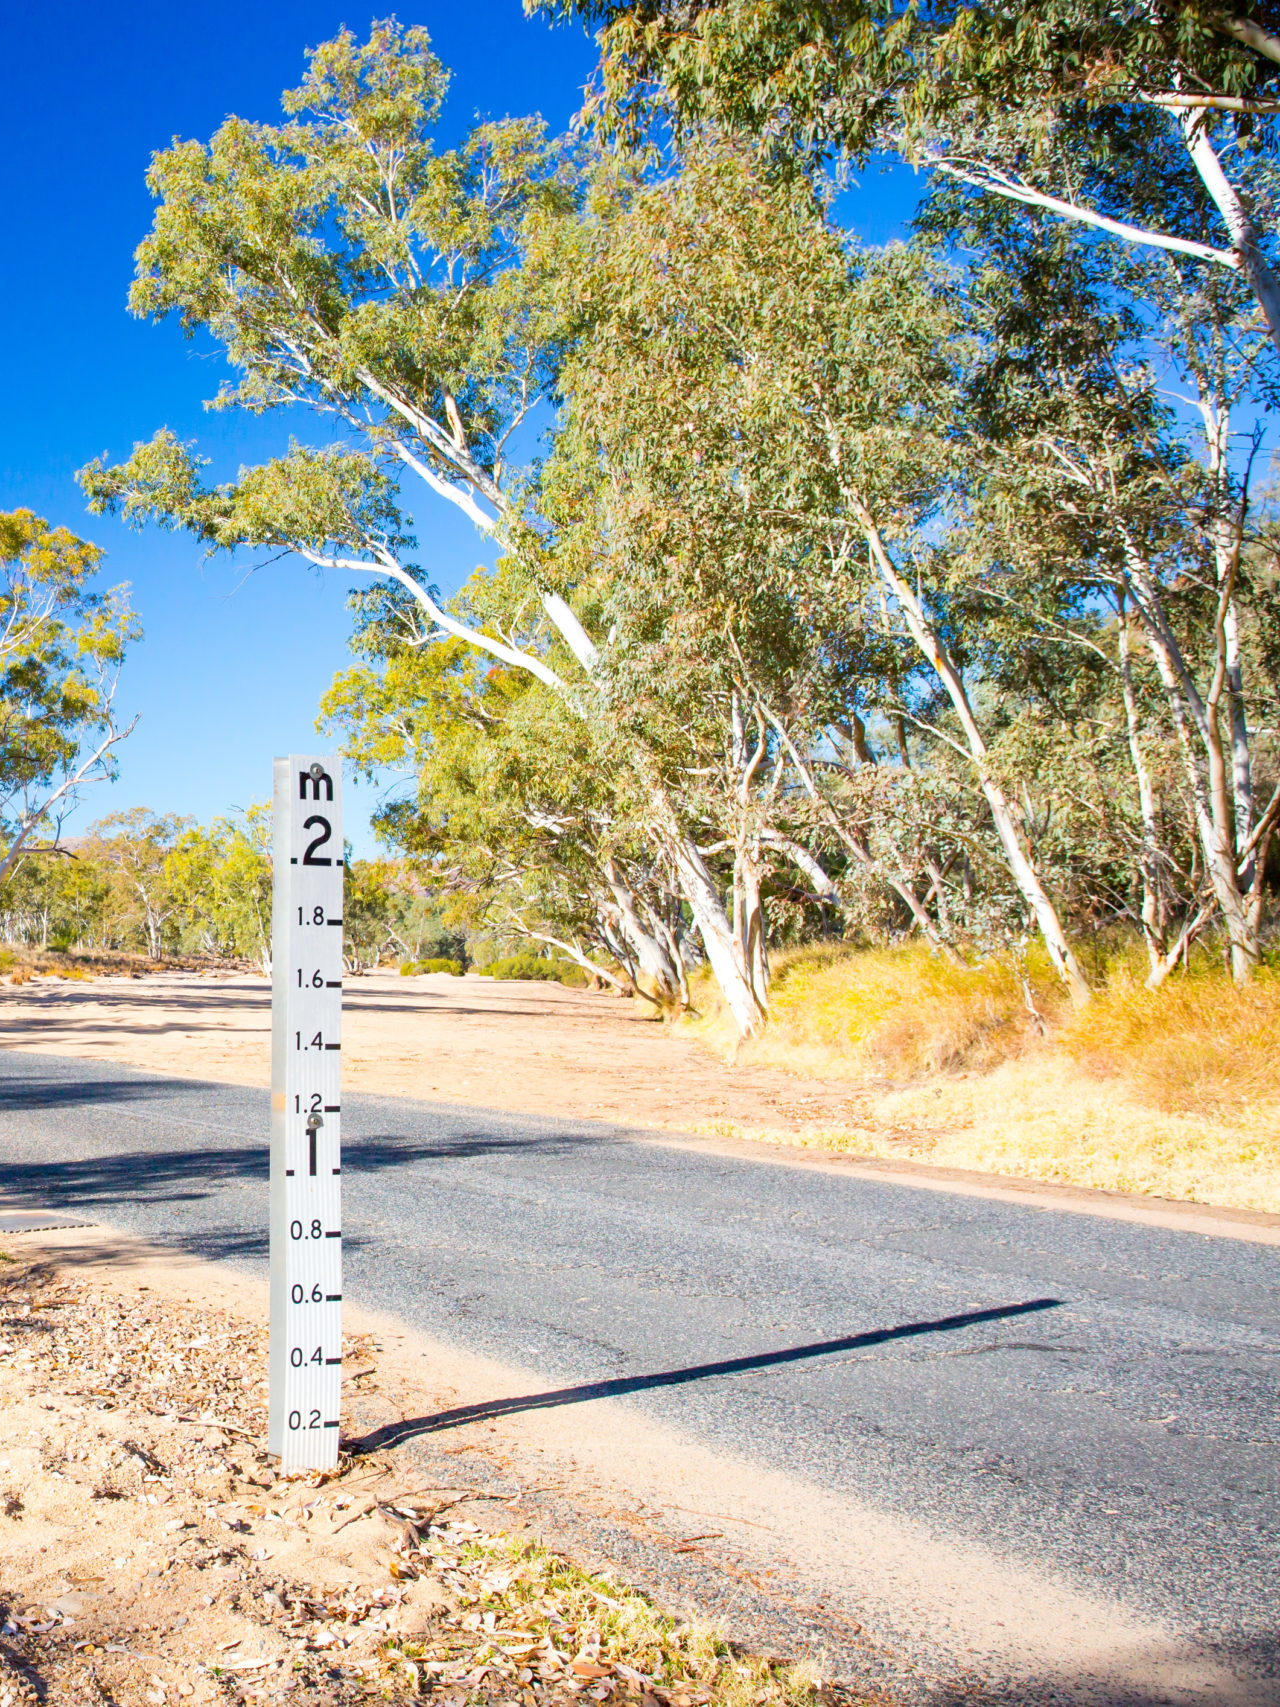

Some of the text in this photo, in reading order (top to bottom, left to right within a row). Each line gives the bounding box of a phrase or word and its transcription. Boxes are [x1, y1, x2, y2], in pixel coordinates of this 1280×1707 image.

[299, 771, 334, 802] m
[303, 815, 332, 867] 2
[297, 905, 325, 926] 1.8
[297, 968, 324, 989] 1.6
[295, 1031, 324, 1051] 1.4
[294, 1093, 323, 1114] 1.2
[305, 1126, 317, 1177] 1
[290, 1219, 322, 1241] 0.8
[291, 1283, 324, 1305] 0.6
[290, 1346, 323, 1368] 0.4
[288, 1409, 322, 1431] 0.2
